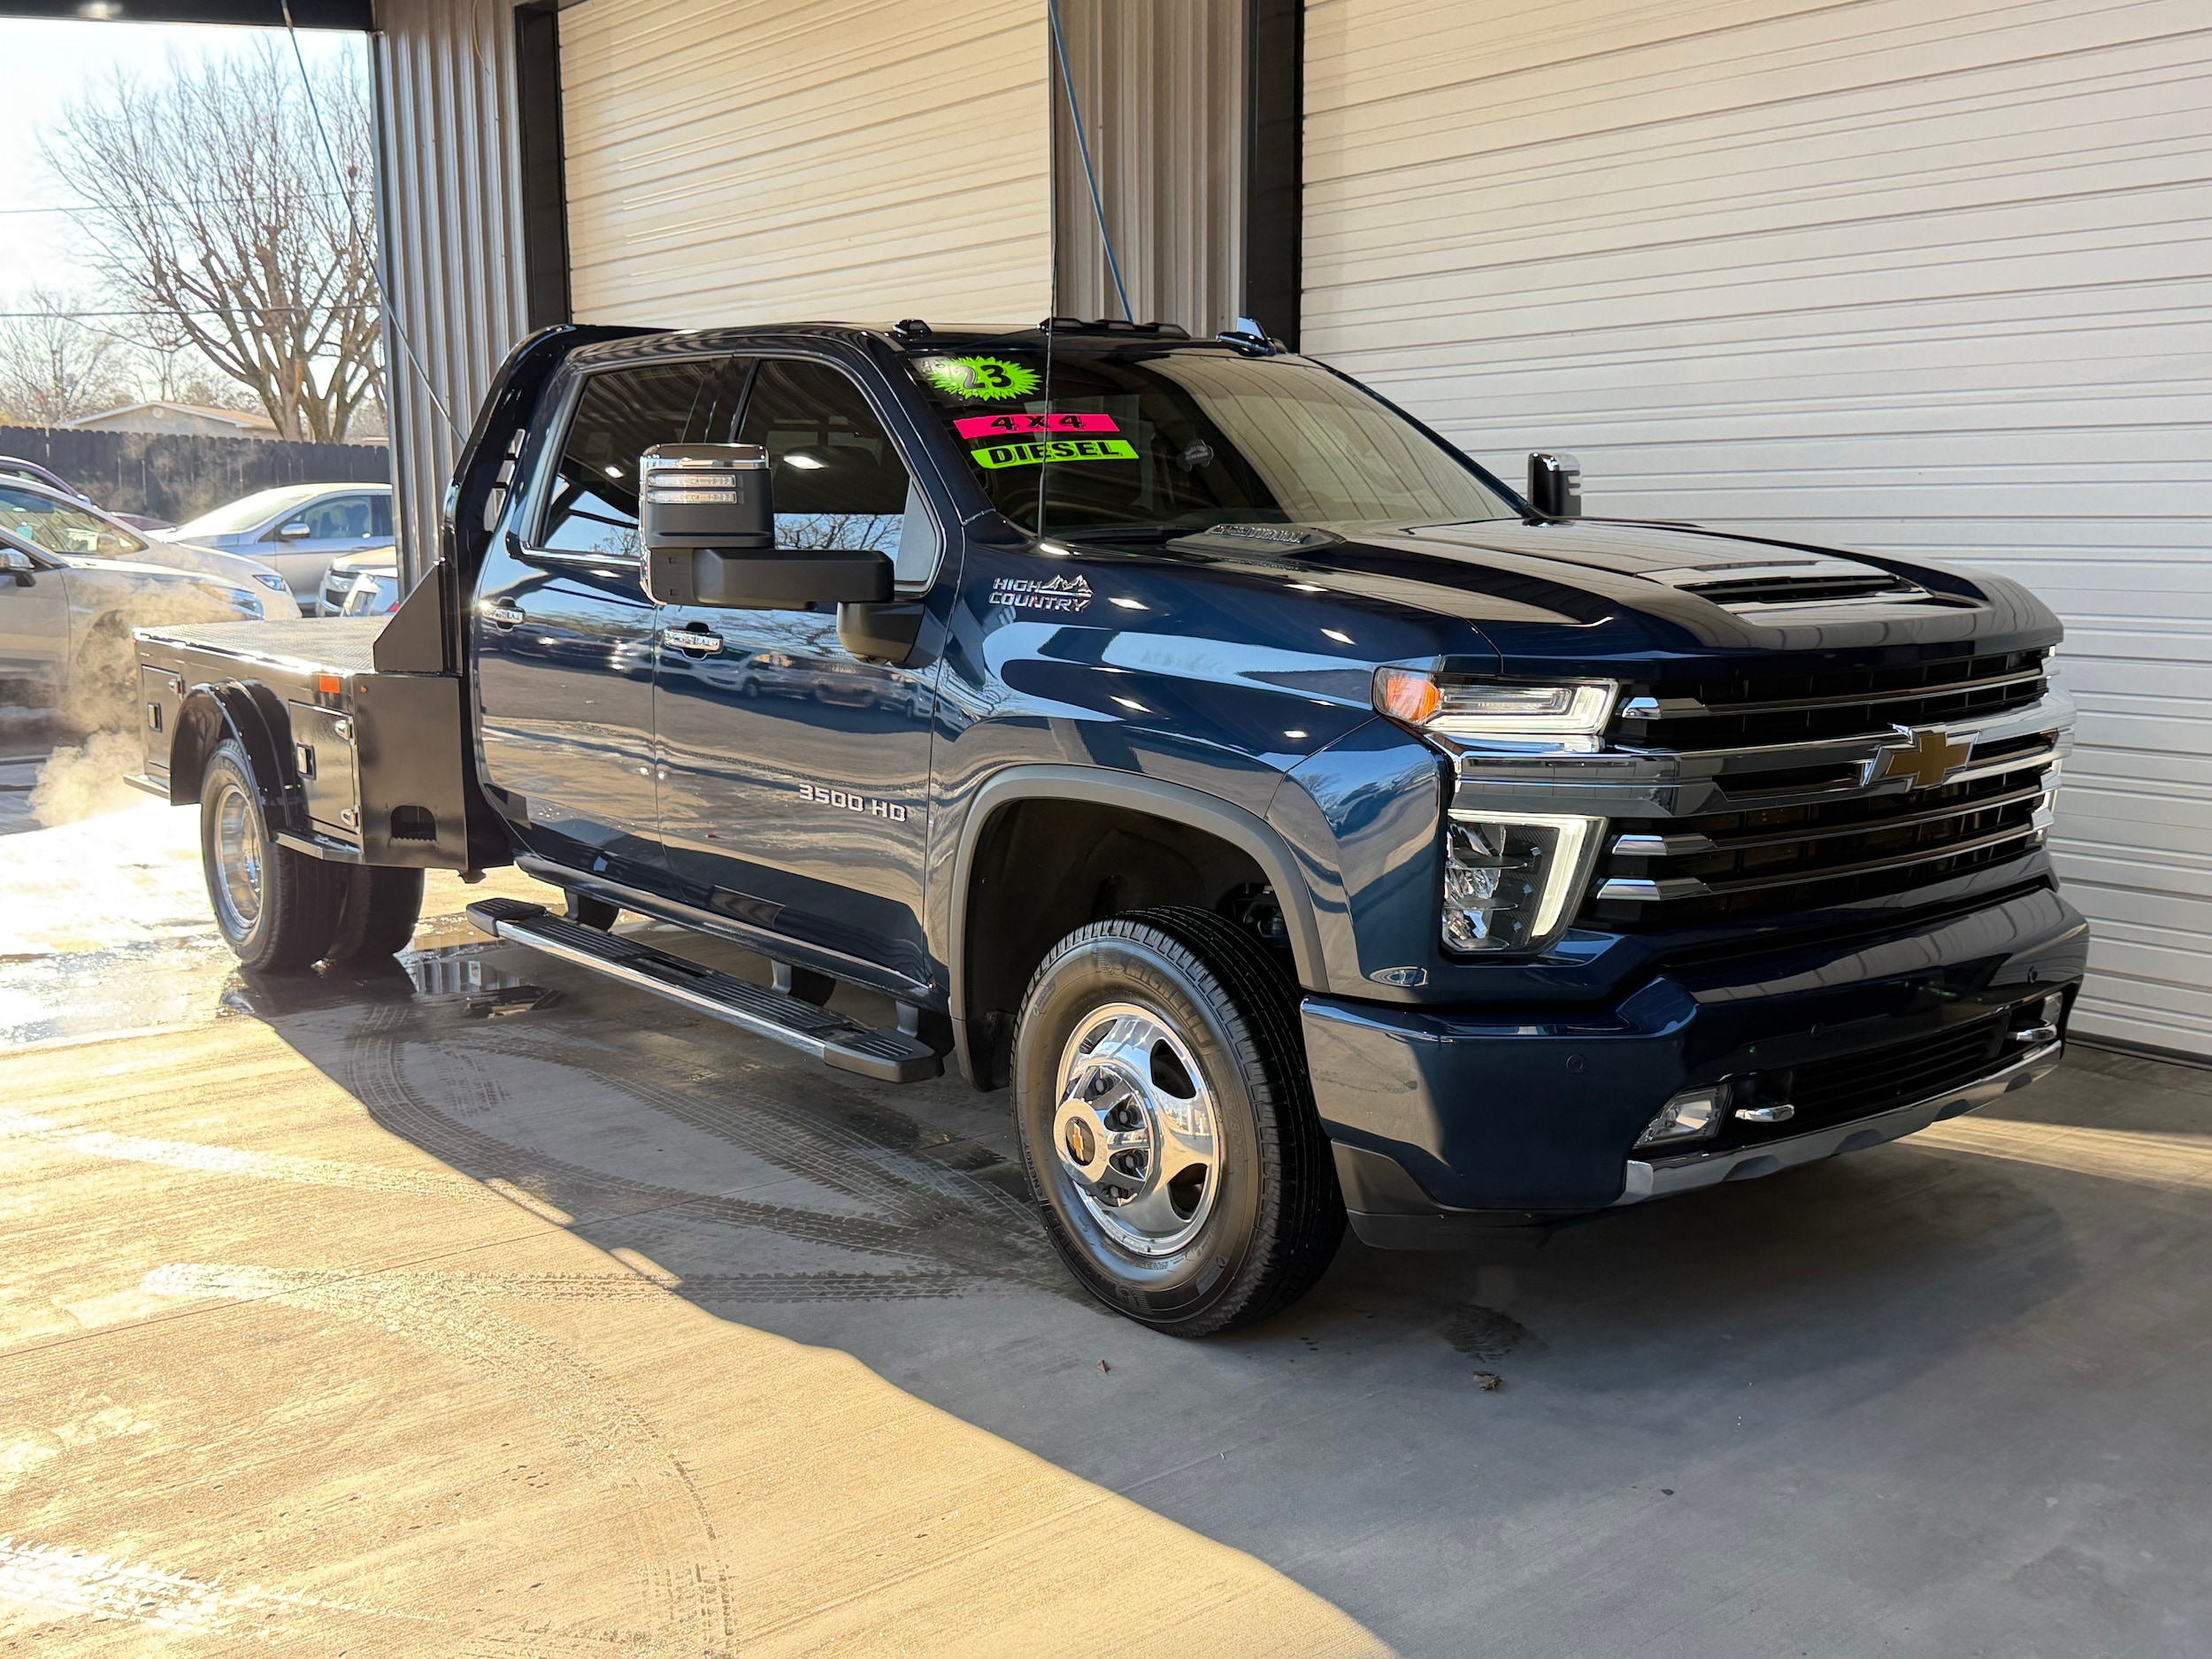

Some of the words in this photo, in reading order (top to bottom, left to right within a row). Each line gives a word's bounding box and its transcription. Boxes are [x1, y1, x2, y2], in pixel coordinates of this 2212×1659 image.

[954, 365, 1013, 389] 23
[988, 442, 1121, 465] DIESEL
[993, 578, 1042, 592] HIGH
[988, 592, 1091, 613] COUNTRY
[799, 783, 864, 812] 3500
[872, 799, 907, 822] HD
[1124, 959, 1214, 1046] MICHELIN
[1022, 1142, 1043, 1196] ENERGY
